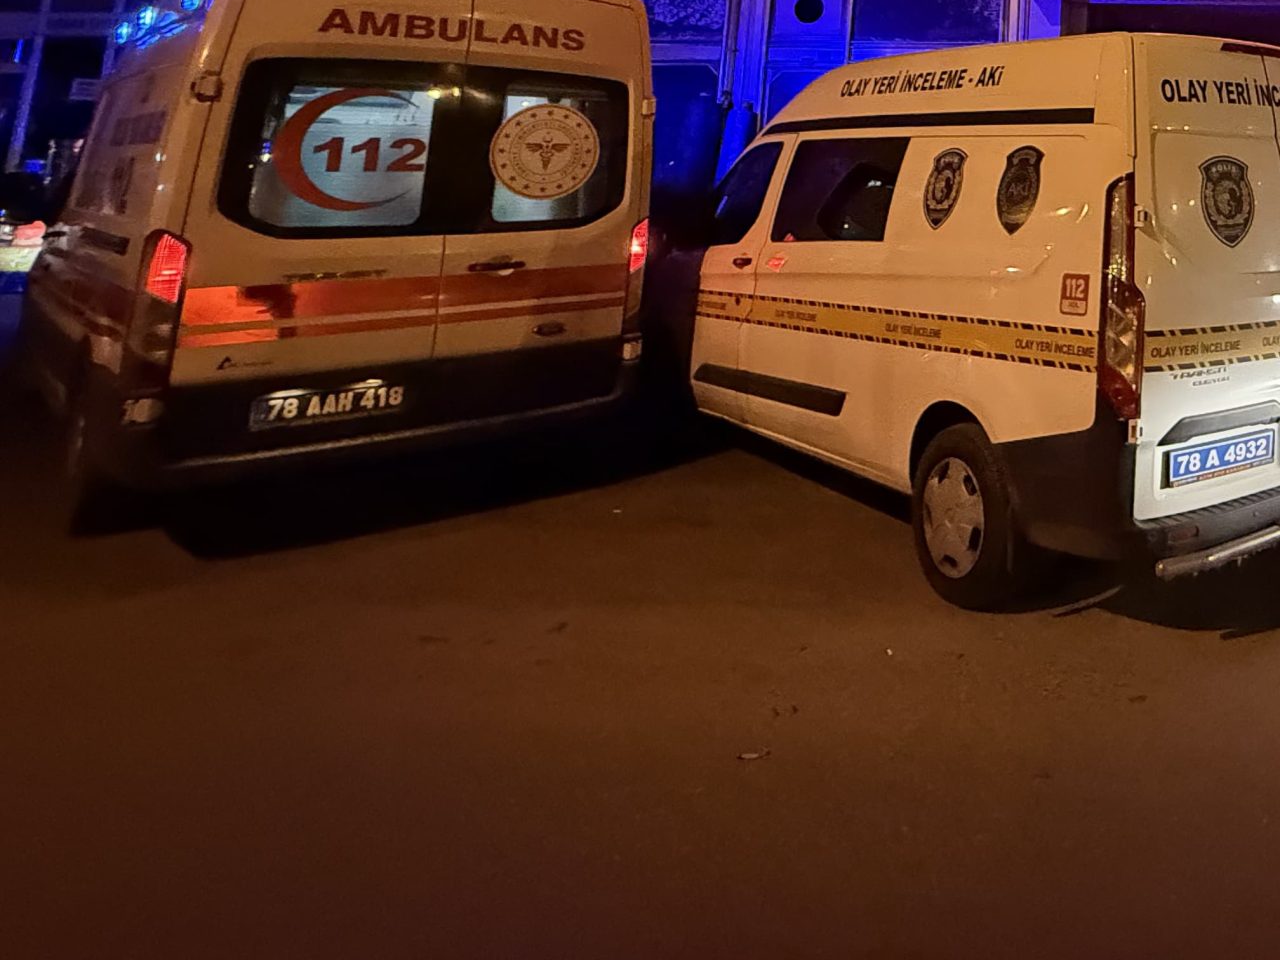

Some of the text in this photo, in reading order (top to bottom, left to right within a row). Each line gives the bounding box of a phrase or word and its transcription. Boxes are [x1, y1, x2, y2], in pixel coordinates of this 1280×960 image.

[318, 8, 585, 51] AMBULANS
[840, 78, 871, 97] OLAY
[871, 71, 902, 95] YERİ
[899, 69, 968, 93] İNCELEME
[1161, 79, 1208, 103] OLAY
[1213, 77, 1250, 105] YERİ
[313, 137, 427, 172] 112
[1065, 278, 1085, 298] 112
[1015, 339, 1034, 350] OLAY
[1151, 339, 1241, 359] OLAY YERİ İNCELEME
[267, 387, 404, 421] 78 AAH 418
[1176, 438, 1267, 474] 78 A 4932
